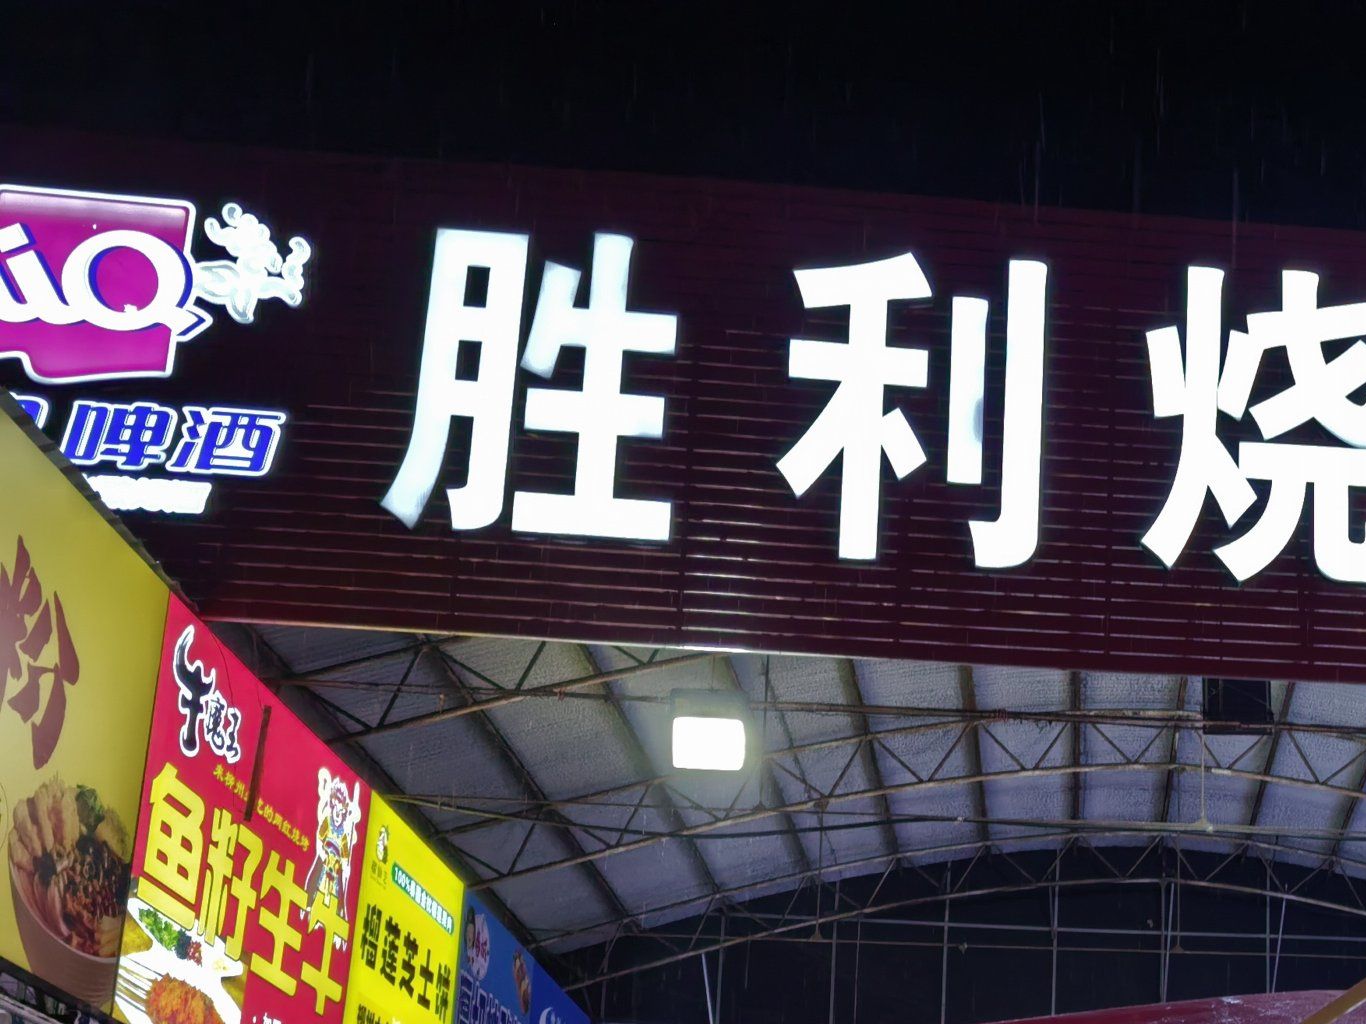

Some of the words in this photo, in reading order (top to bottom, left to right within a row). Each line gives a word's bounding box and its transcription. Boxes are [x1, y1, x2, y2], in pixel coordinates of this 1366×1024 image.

[137, 762, 350, 1017] 鱼籽生牛
[360, 903, 451, 1024] 榴莲芝士饼
